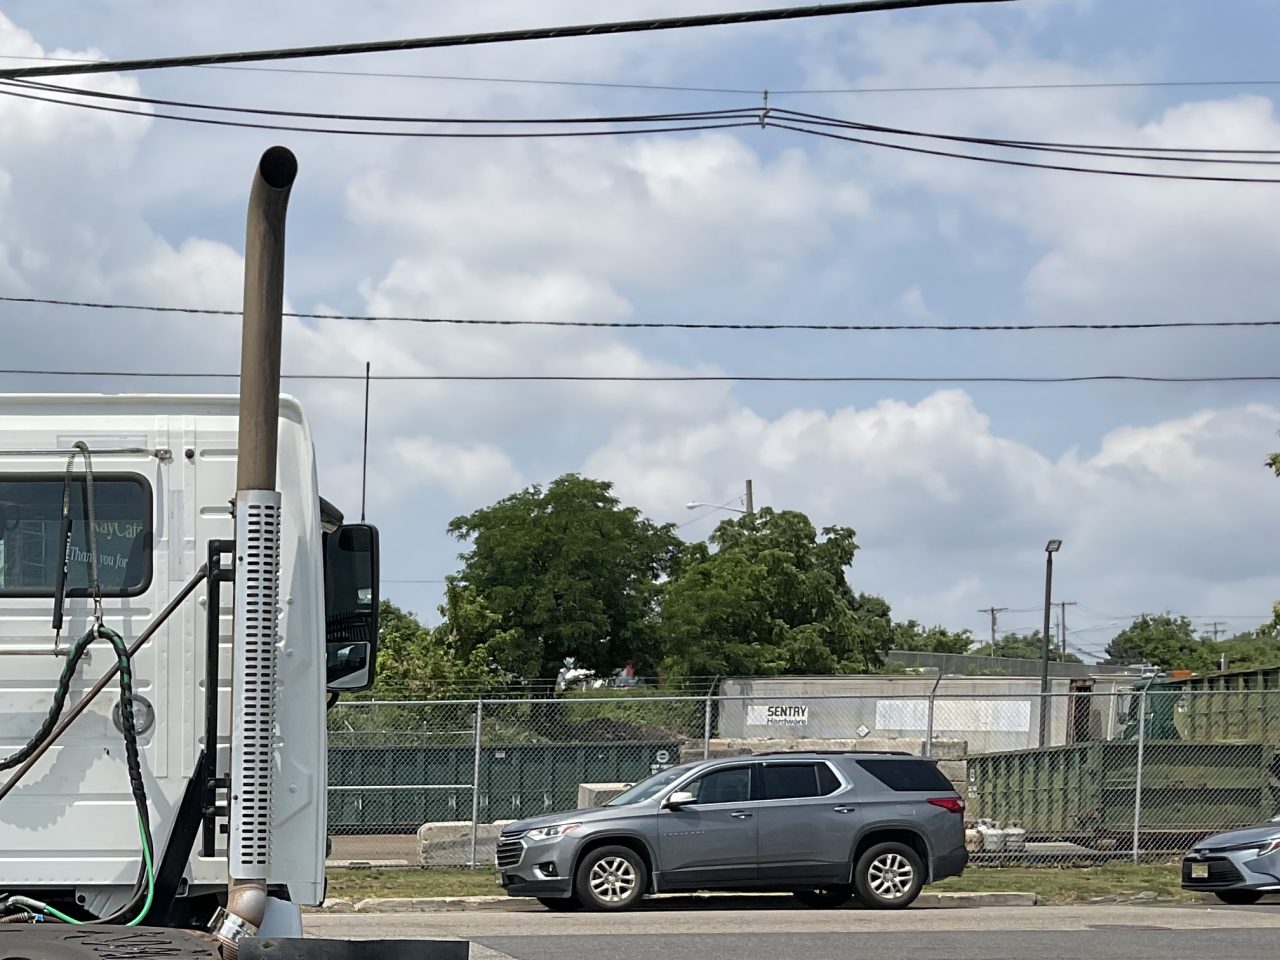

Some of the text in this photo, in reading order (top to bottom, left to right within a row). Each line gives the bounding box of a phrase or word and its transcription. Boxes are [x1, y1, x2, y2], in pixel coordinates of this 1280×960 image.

[70, 546, 129, 569] Than you for
[767, 706, 807, 717] SENTRY
[766, 718, 807, 726] Hardware
